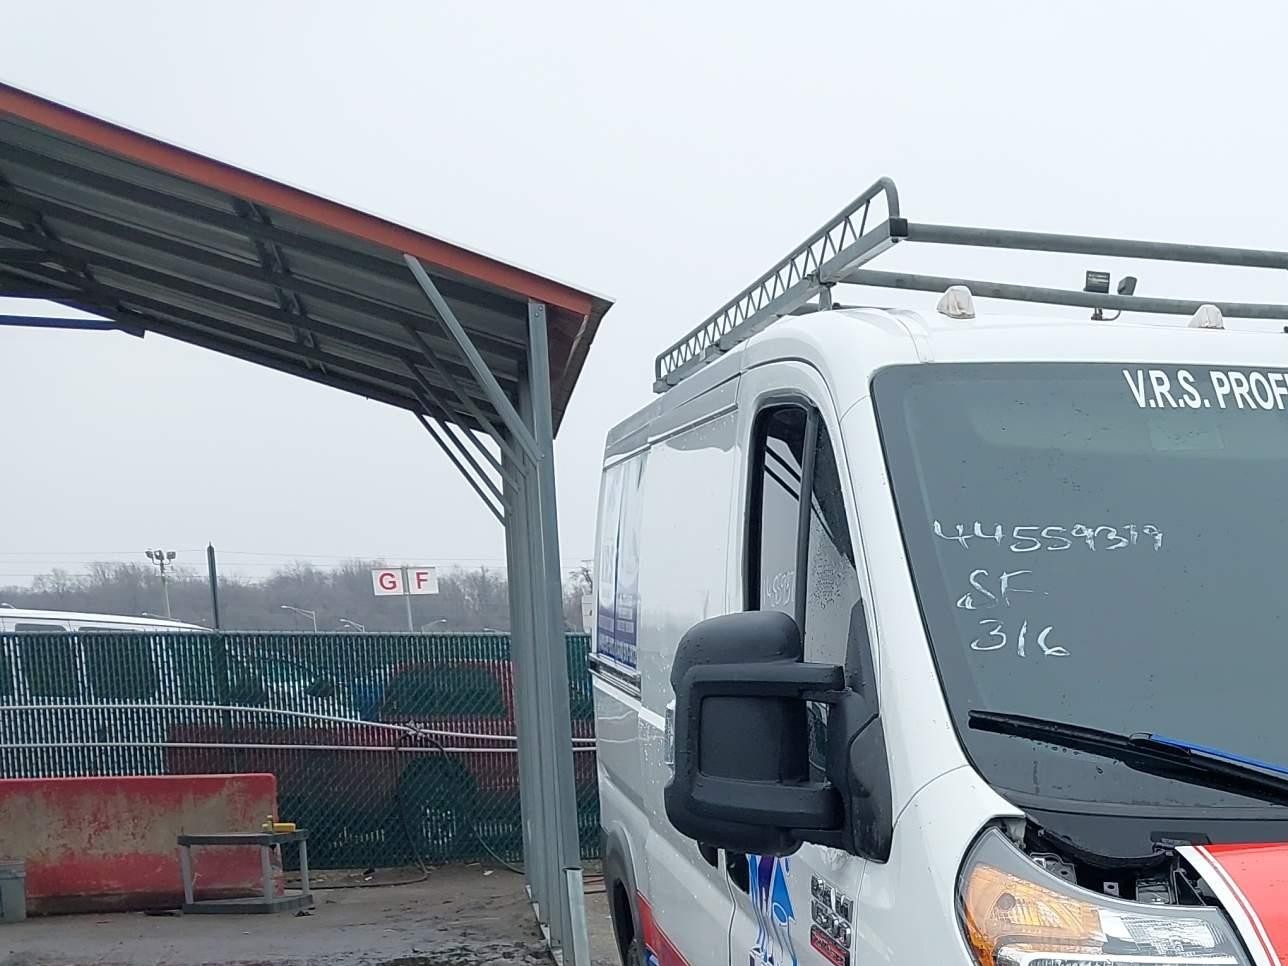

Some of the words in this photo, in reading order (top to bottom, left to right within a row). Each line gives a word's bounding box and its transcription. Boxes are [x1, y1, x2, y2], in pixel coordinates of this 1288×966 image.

[1122, 369, 1210, 408] V.R.S.
[379, 572, 397, 590] G
[415, 572, 429, 589] F
